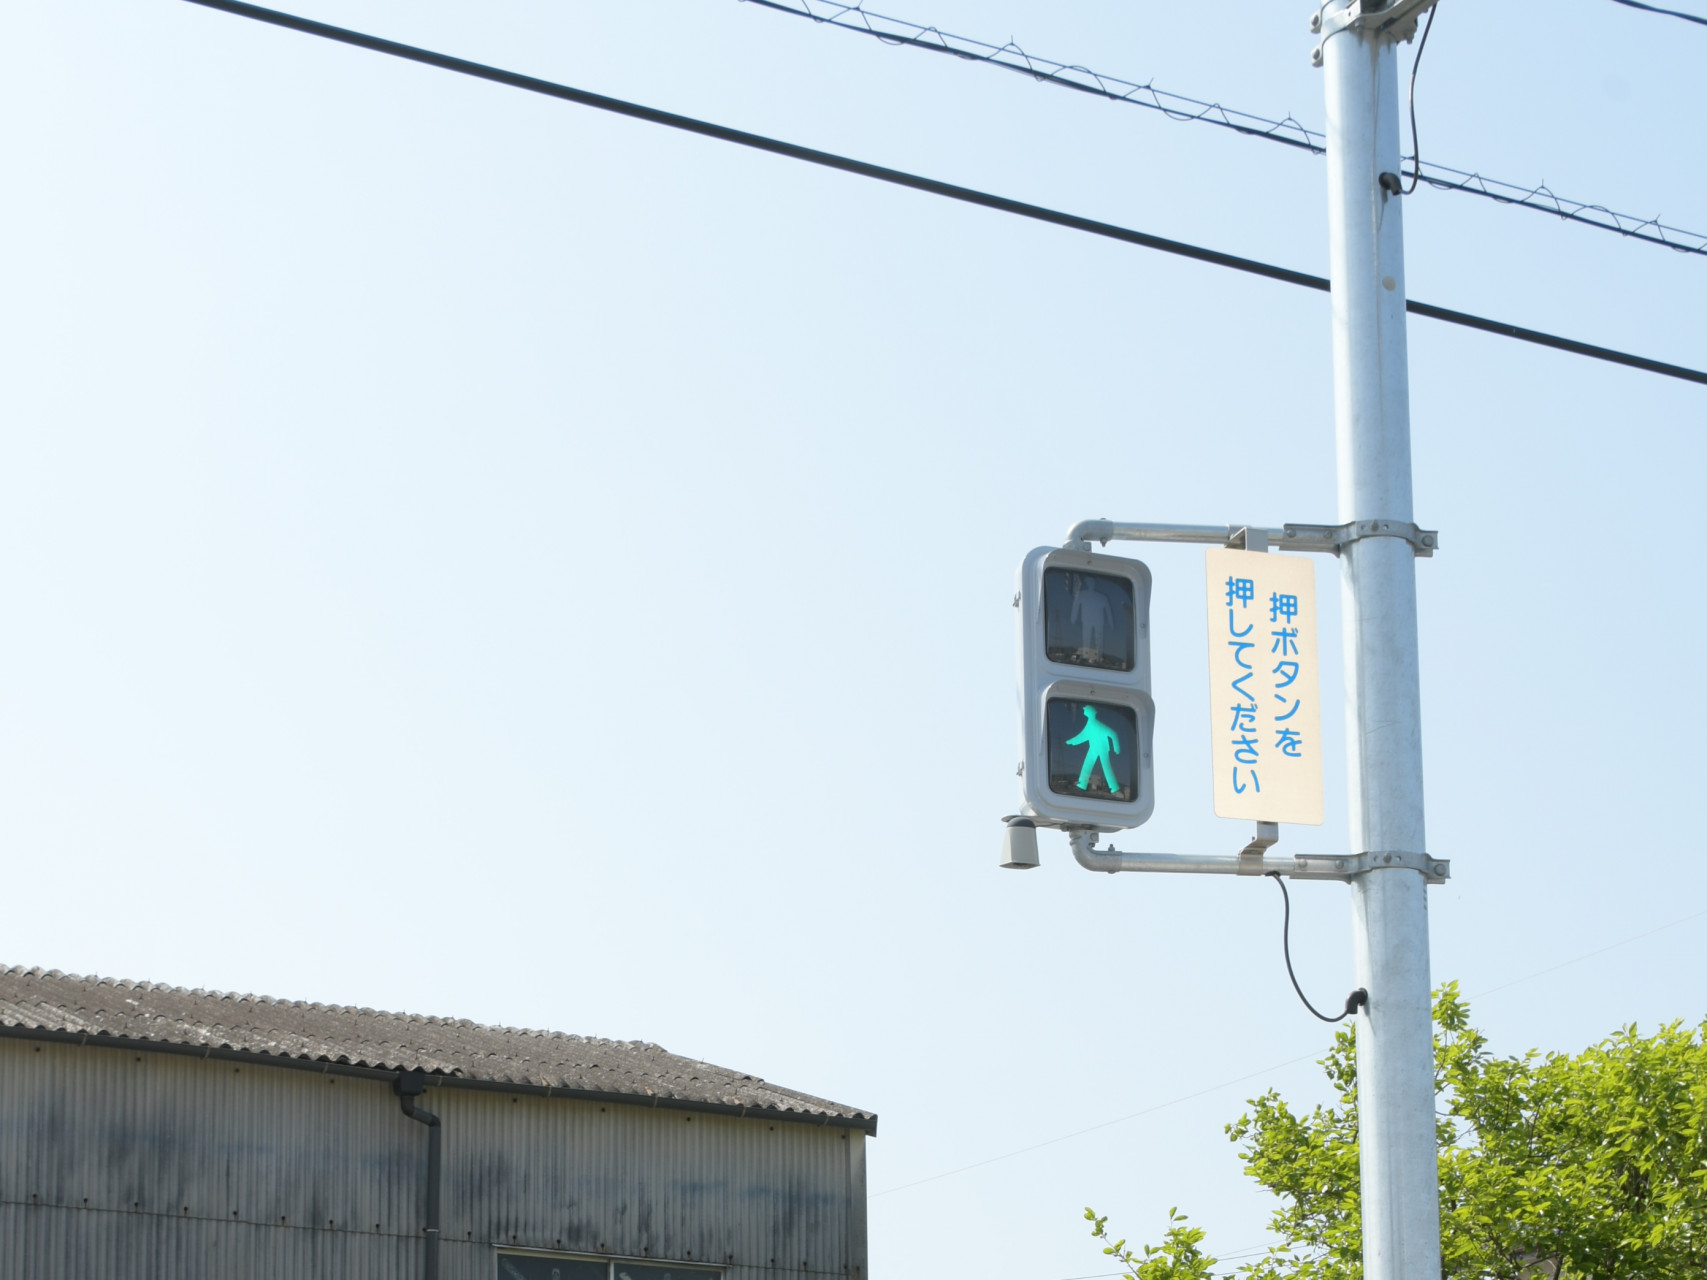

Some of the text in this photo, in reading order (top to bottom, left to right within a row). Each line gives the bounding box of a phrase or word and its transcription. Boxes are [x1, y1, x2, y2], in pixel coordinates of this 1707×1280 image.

[1225, 576, 1260, 794] 押してください
[1269, 592, 1302, 757] 押ボタンを
